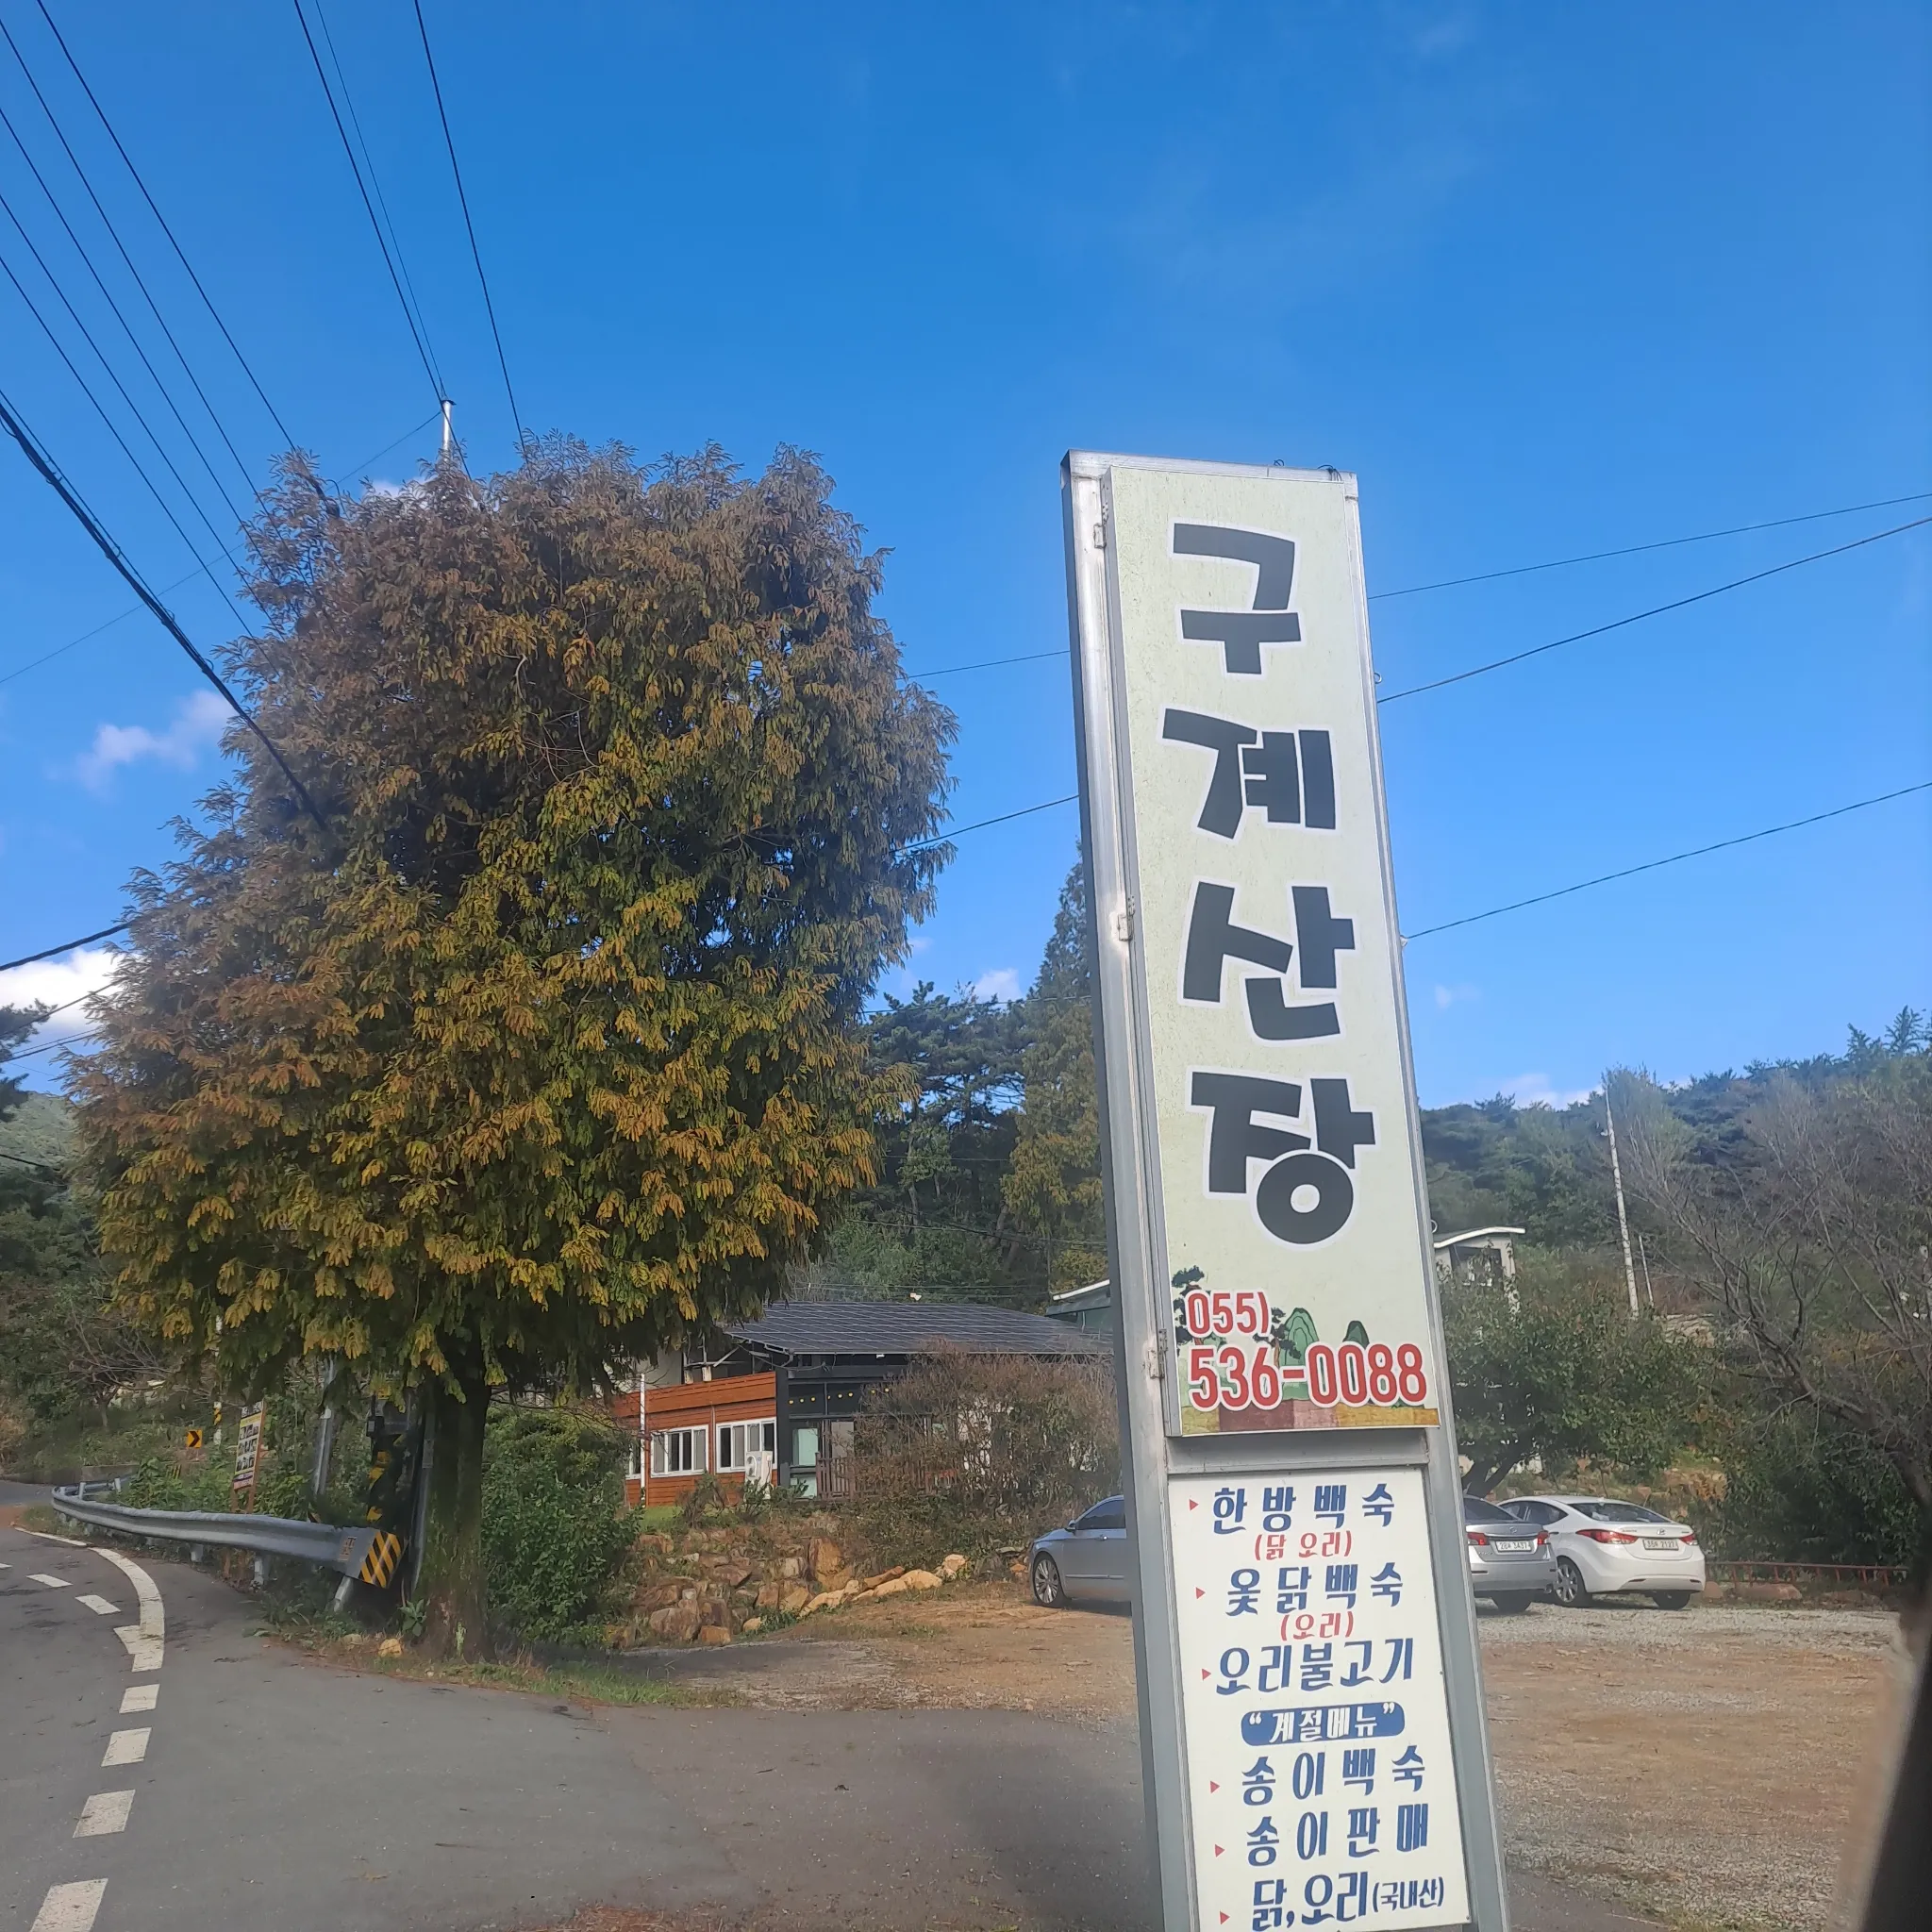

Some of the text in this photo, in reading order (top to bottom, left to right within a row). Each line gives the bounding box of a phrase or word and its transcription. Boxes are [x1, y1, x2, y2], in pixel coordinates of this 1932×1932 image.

[1161, 523, 1375, 1244] 구계산장
[1186, 1291, 1270, 1337] 055)
[1190, 1342, 1427, 1408] 536-0088
[1213, 1483, 1395, 1535] 한방백숙
[1225, 1562, 1404, 1617] 옻닭백숙
[1280, 1611, 1355, 1641] (오리)
[1216, 1638, 1414, 1695] 오리불고기
[1241, 1744, 1425, 1806] 송이백숙
[1247, 1803, 1429, 1867] 송이판매
